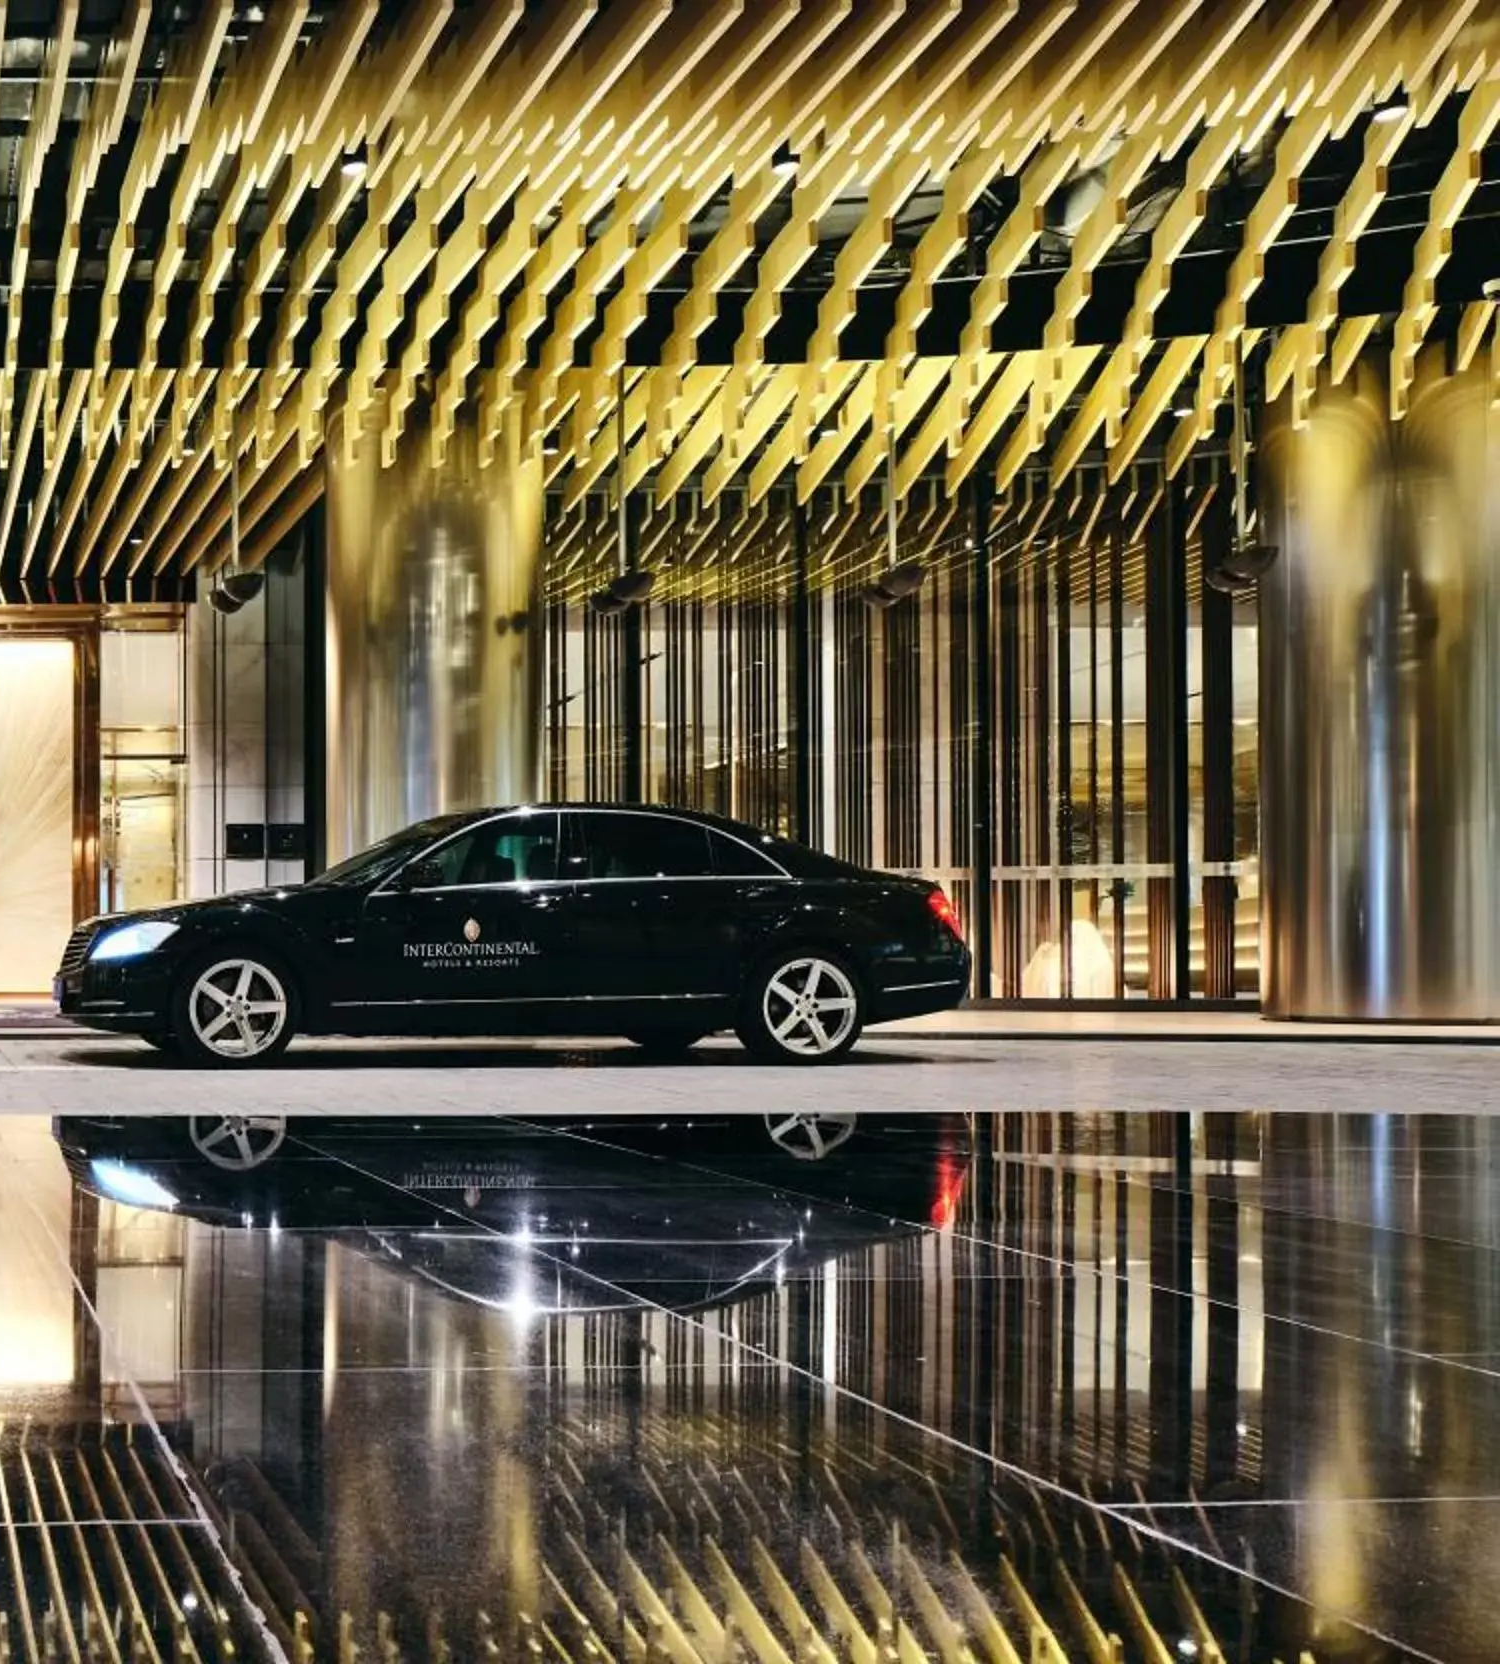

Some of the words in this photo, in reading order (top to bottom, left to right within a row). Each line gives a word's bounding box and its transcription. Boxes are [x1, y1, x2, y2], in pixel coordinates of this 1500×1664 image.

[403, 941, 539, 957] INTERCONTINENTAL
[422, 959, 461, 968] HOTELS
[476, 958, 519, 967] RESORTS
